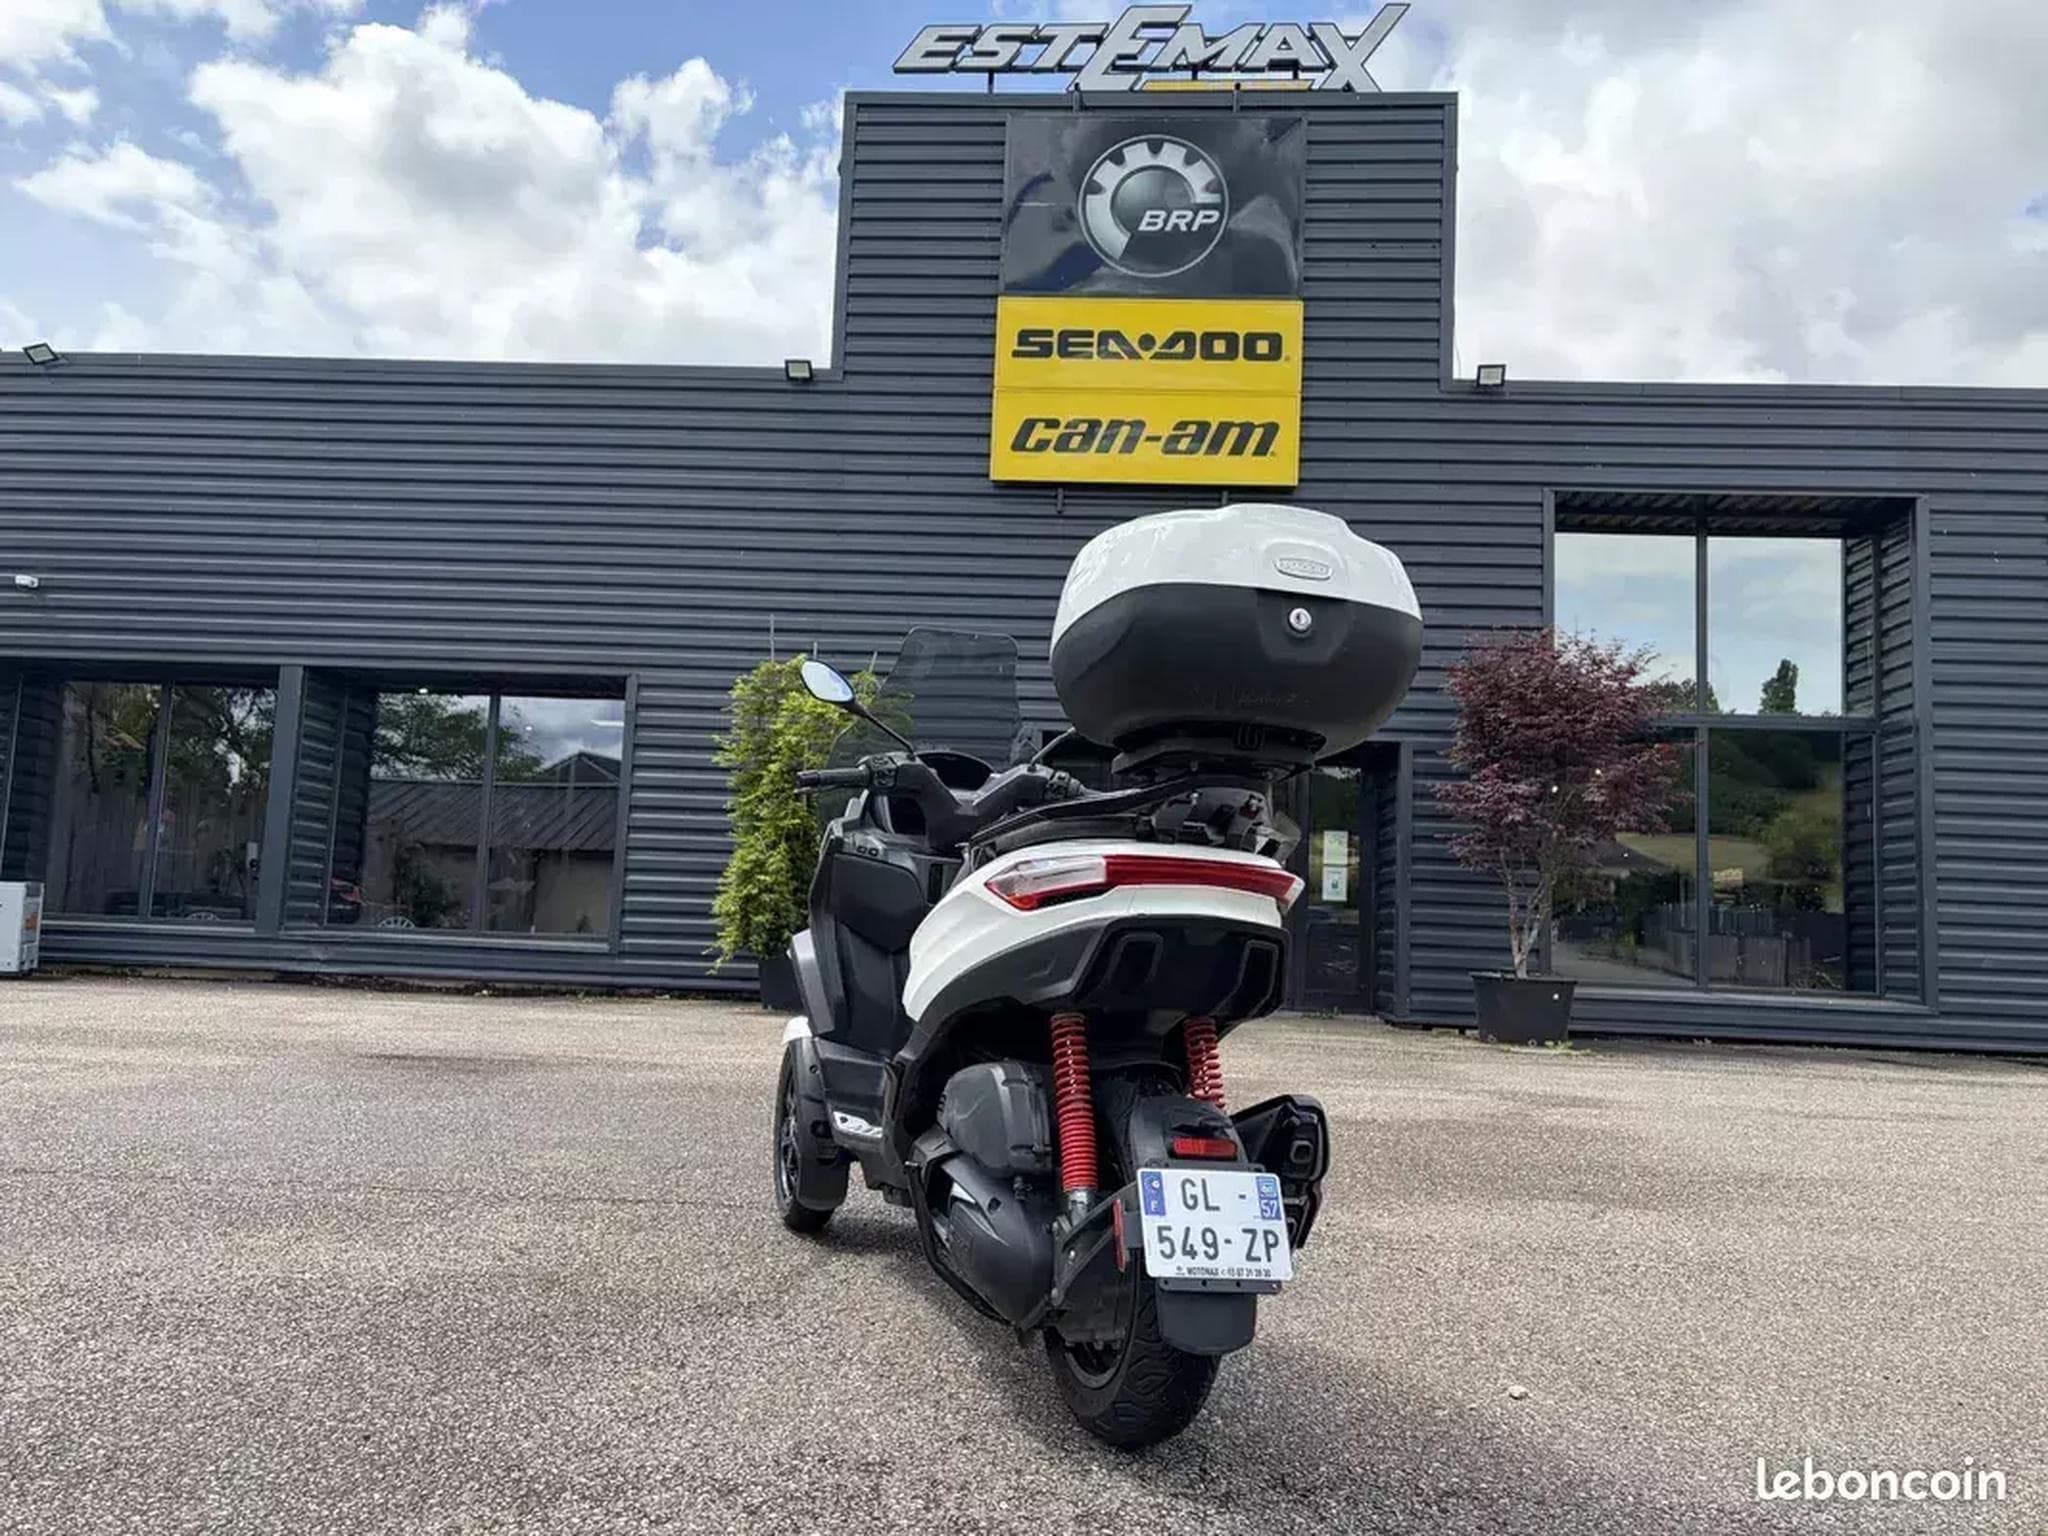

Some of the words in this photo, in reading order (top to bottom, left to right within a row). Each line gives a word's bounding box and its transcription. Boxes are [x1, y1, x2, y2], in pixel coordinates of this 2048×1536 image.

[893, 3, 1410, 93] ESTEMAX
[1137, 209, 1221, 233] BRP
[1009, 416, 1281, 458] can-am
[1180, 1177, 1221, 1213] GL
[1260, 1199, 1278, 1219] 57
